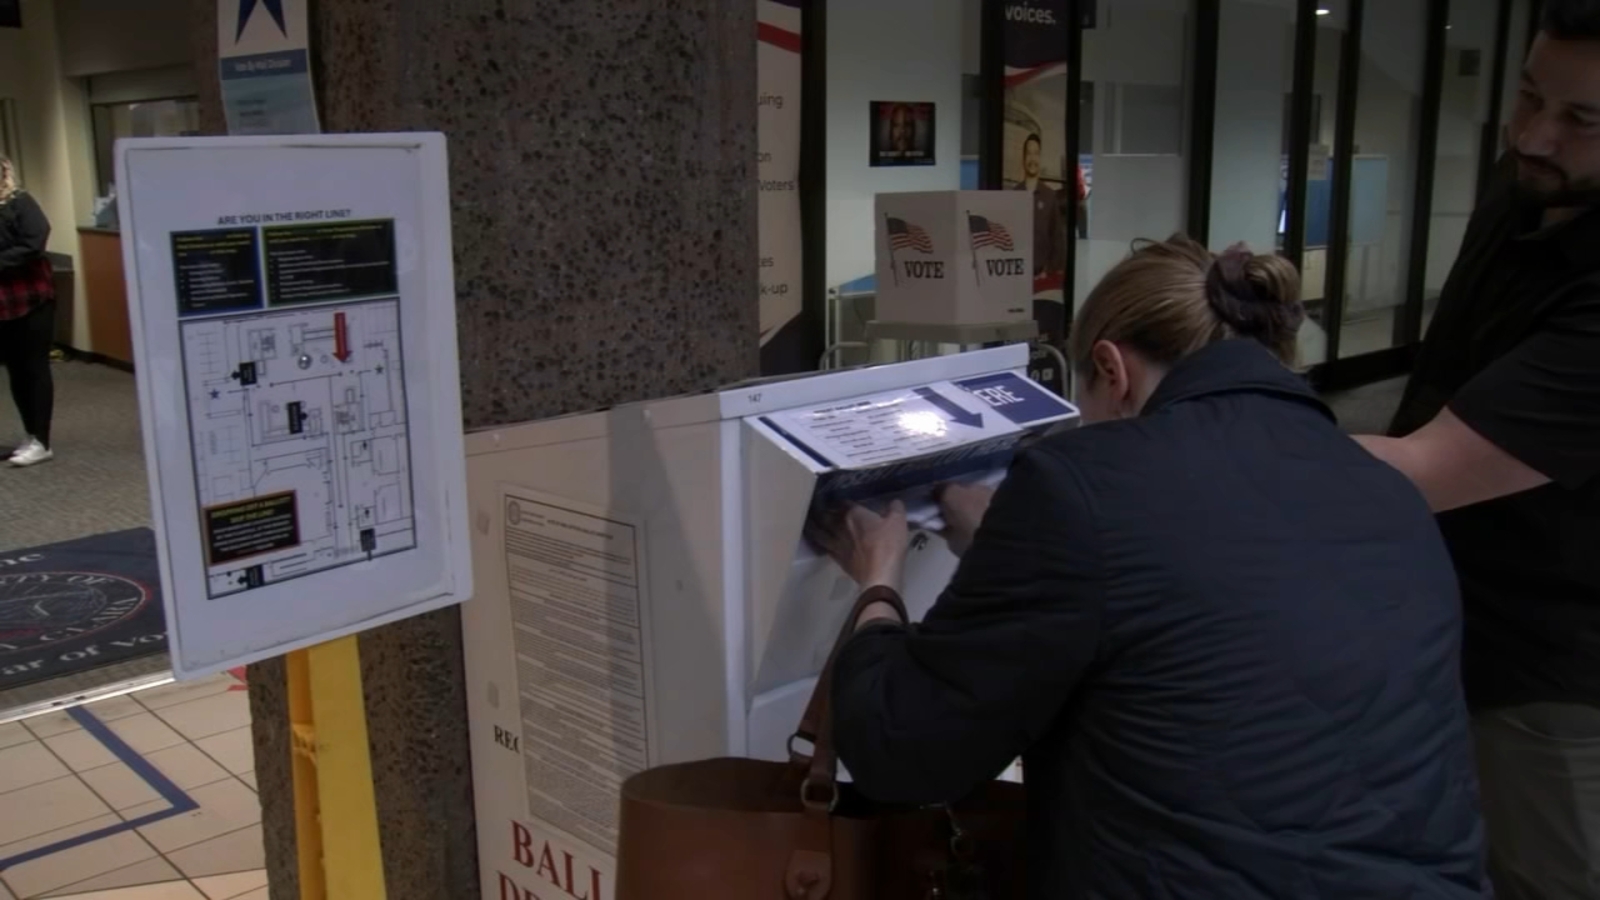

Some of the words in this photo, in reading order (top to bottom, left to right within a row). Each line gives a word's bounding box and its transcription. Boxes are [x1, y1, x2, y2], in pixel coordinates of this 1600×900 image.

[1004, 1, 1056, 25] voices.
[218, 215, 237, 225] ARE
[240, 214, 261, 223] YOU
[263, 213, 273, 222] IN
[275, 212, 293, 221] THE
[295, 210, 323, 220] RIGHT
[325, 209, 351, 218] LINE?
[904, 261, 945, 279] VOTE
[985, 258, 1025, 277] VOTE
[967, 385, 1026, 407] ERE
